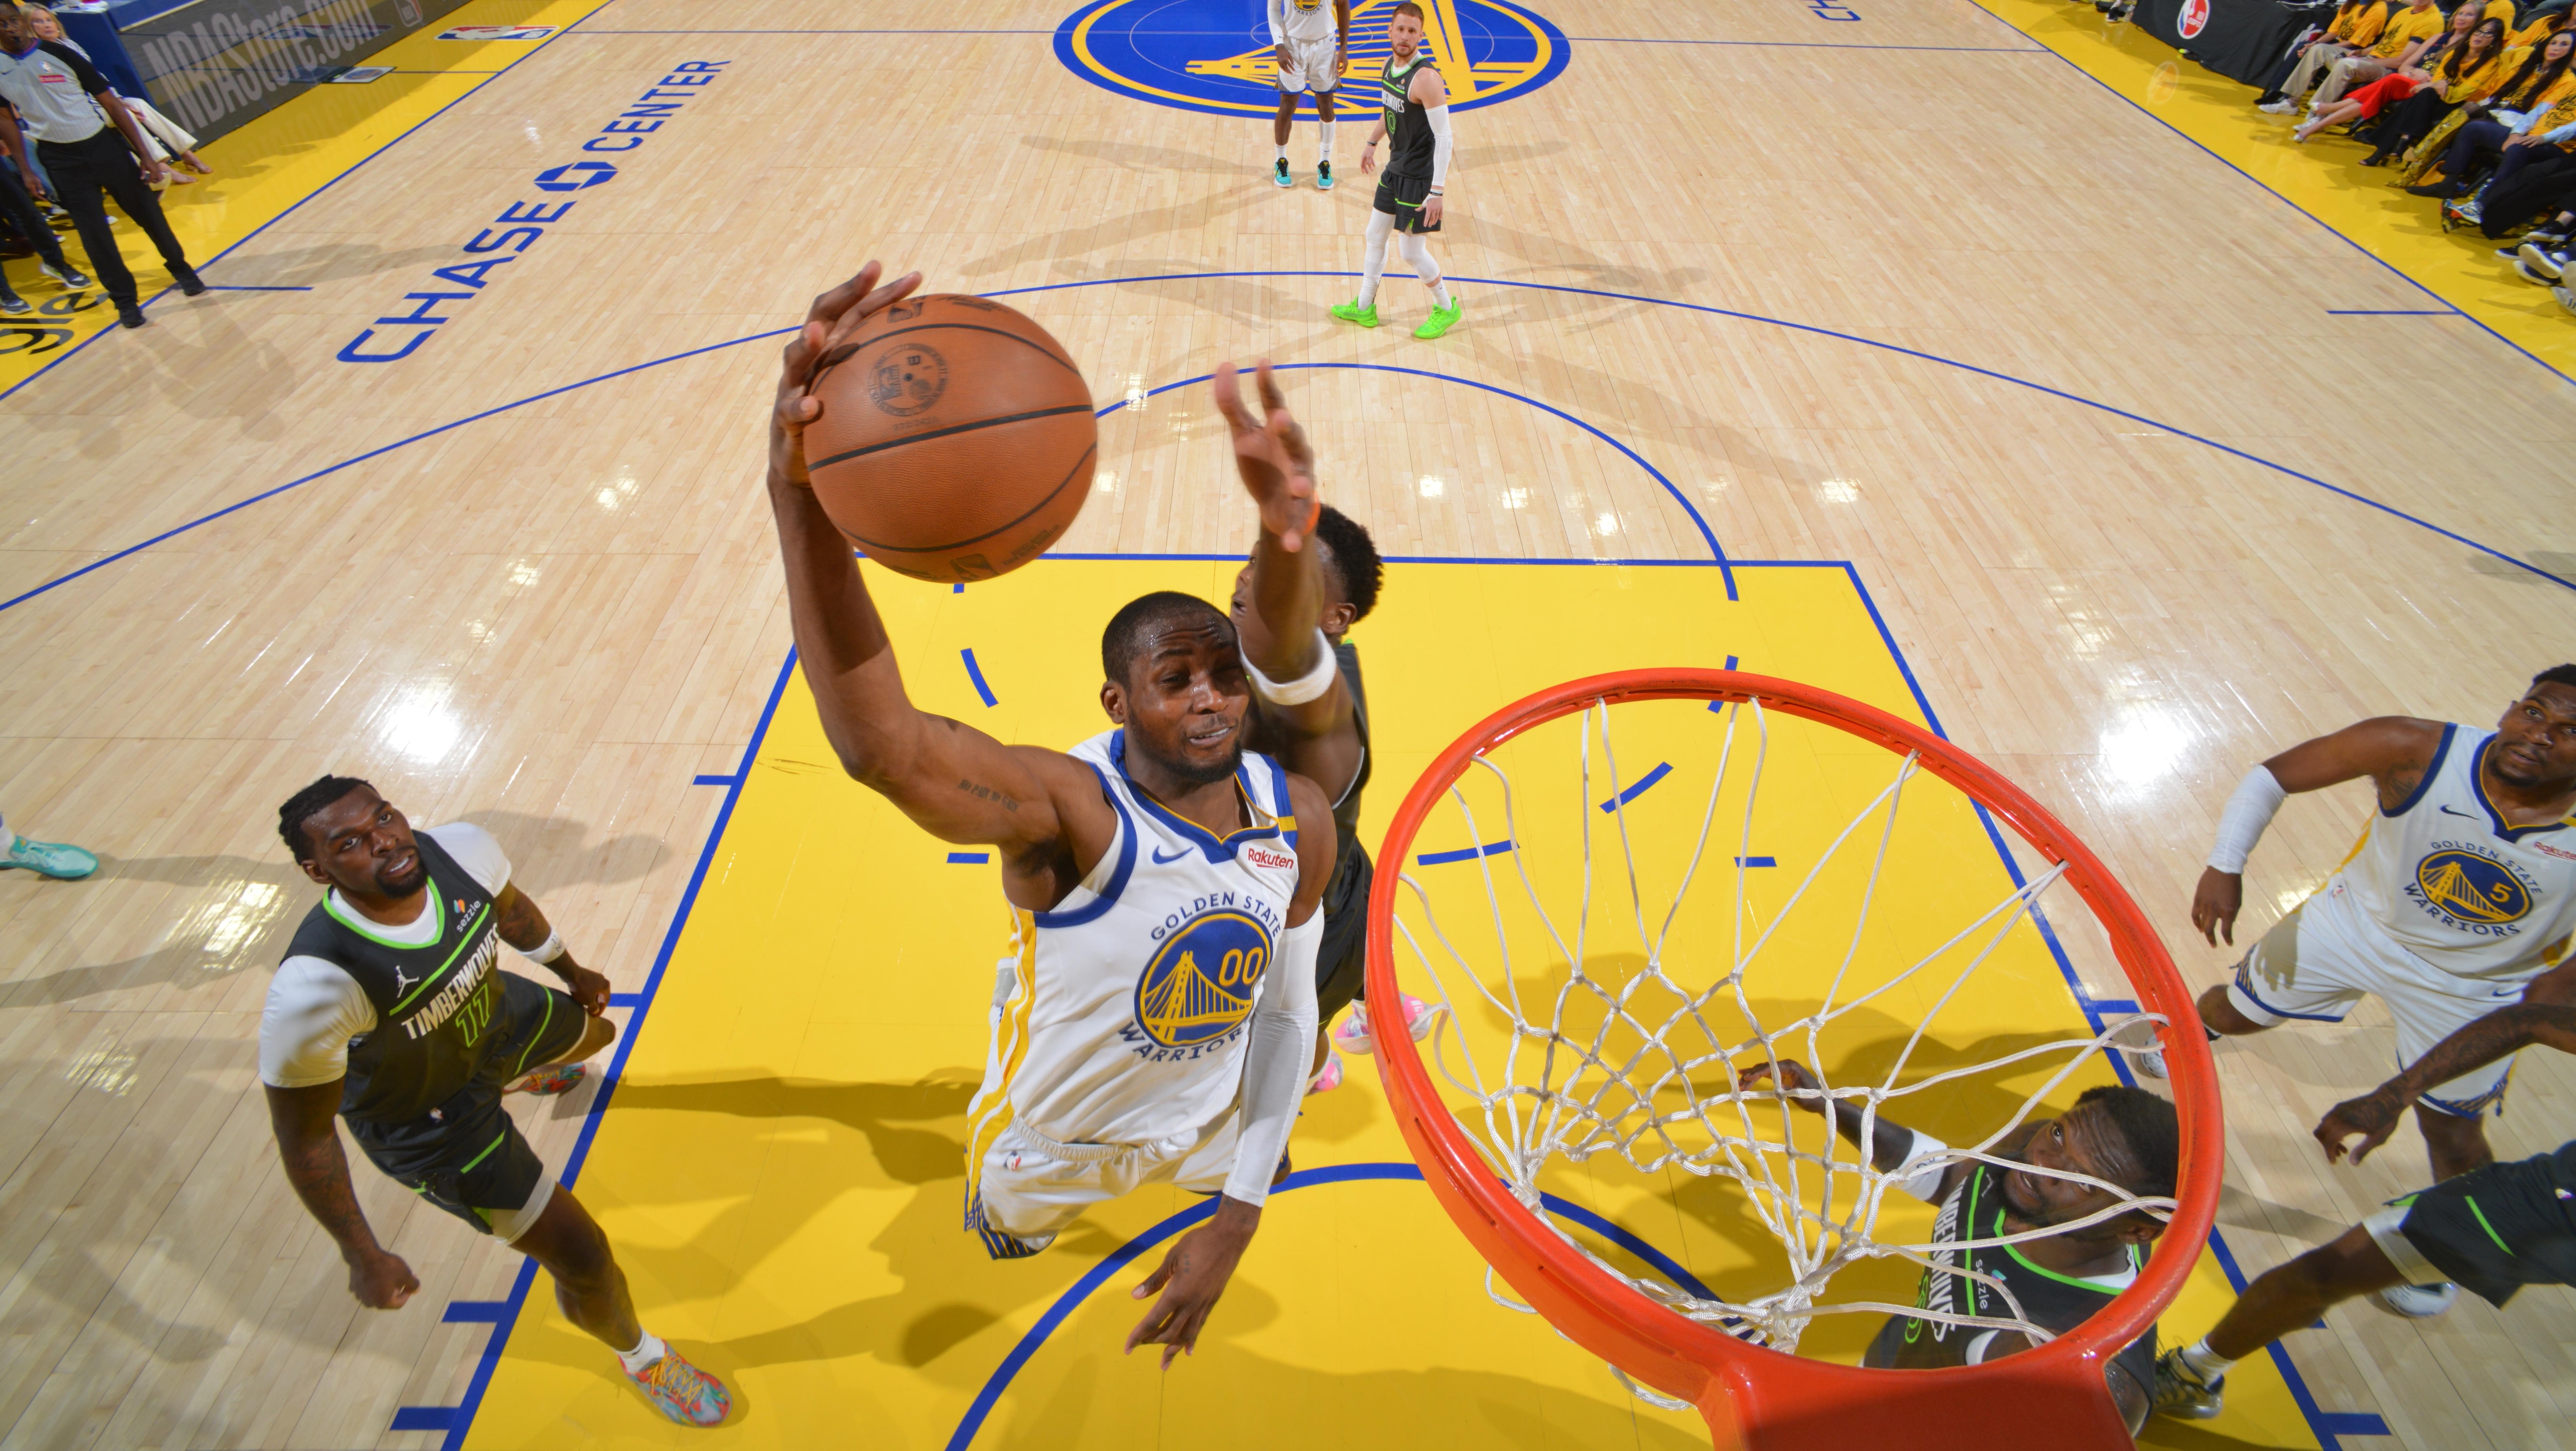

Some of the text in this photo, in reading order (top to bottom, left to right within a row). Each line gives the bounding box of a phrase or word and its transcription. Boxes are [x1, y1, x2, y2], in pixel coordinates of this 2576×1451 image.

[1294, 4, 1323, 16] WARRIORS
[142, 0, 380, 134] NBAStore.com
[336, 60, 732, 363] CHASE CENTER
[1248, 848, 1294, 869] Rakuten
[2431, 841, 2543, 895] GOLDEN STATE
[1151, 891, 1281, 940] GOLDEN STATE
[2403, 883, 2521, 937] WARRIORS
[2489, 882, 2513, 903] 5
[456, 901, 481, 933] sezzle
[401, 922, 499, 1040] TIMBERWOLVES
[1218, 947, 1263, 987] 00
[1118, 1017, 1249, 1062] WARRIOR
